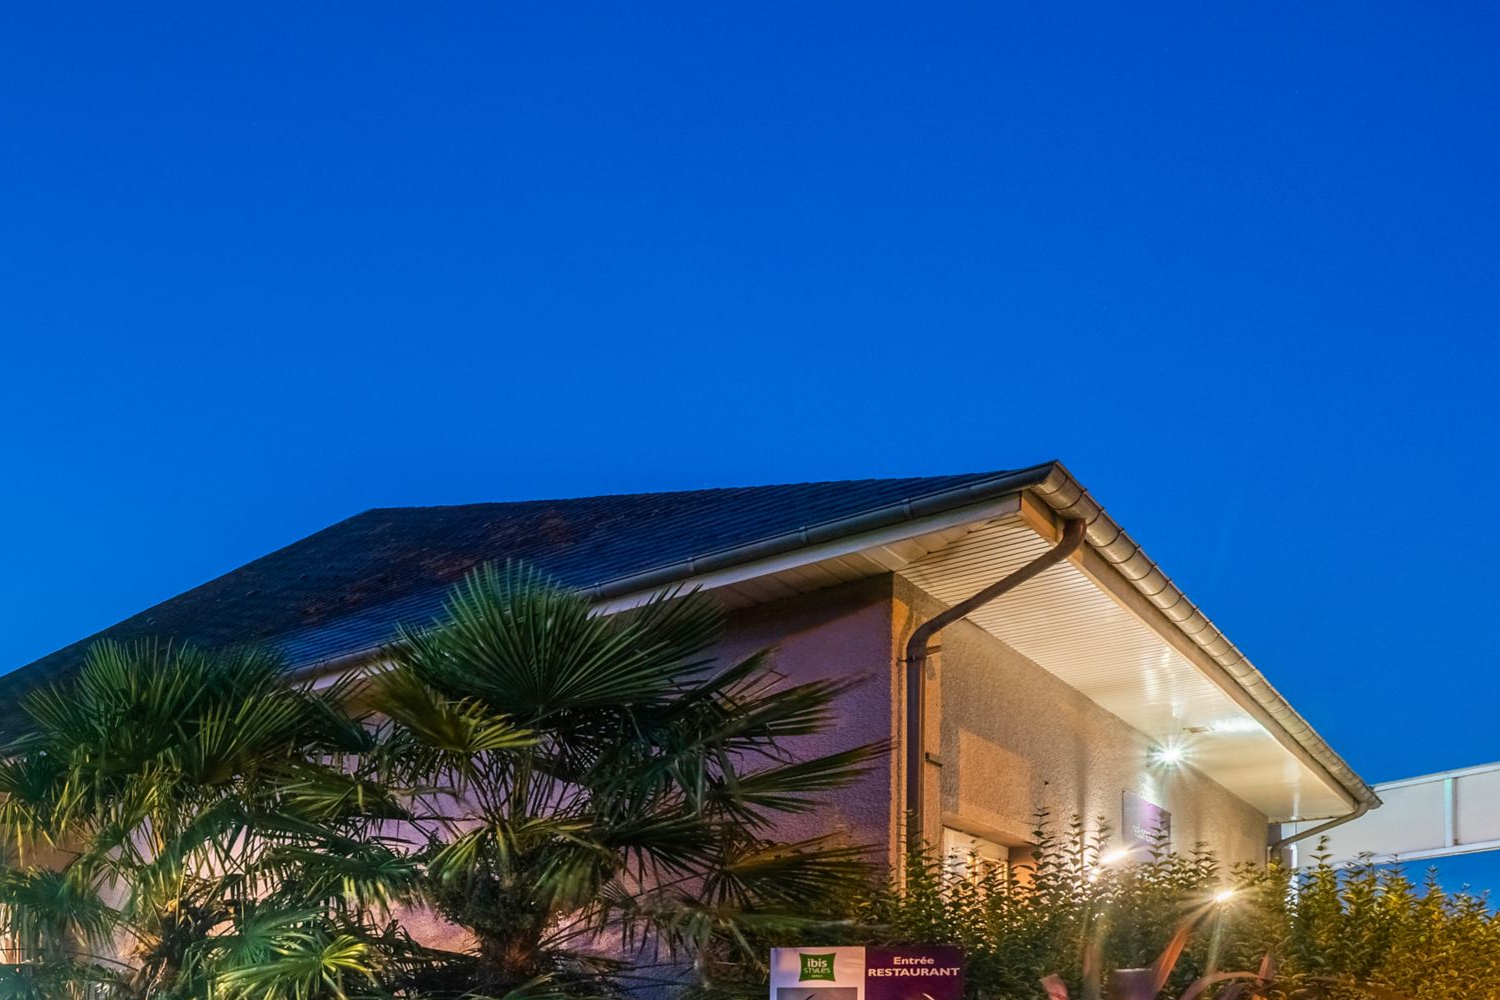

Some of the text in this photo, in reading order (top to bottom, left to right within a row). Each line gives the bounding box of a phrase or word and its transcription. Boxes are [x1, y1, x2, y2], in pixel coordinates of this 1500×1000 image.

[807, 958, 828, 968] ibis
[893, 956, 935, 965] Entrée
[868, 967, 960, 977] RESTAURANT
